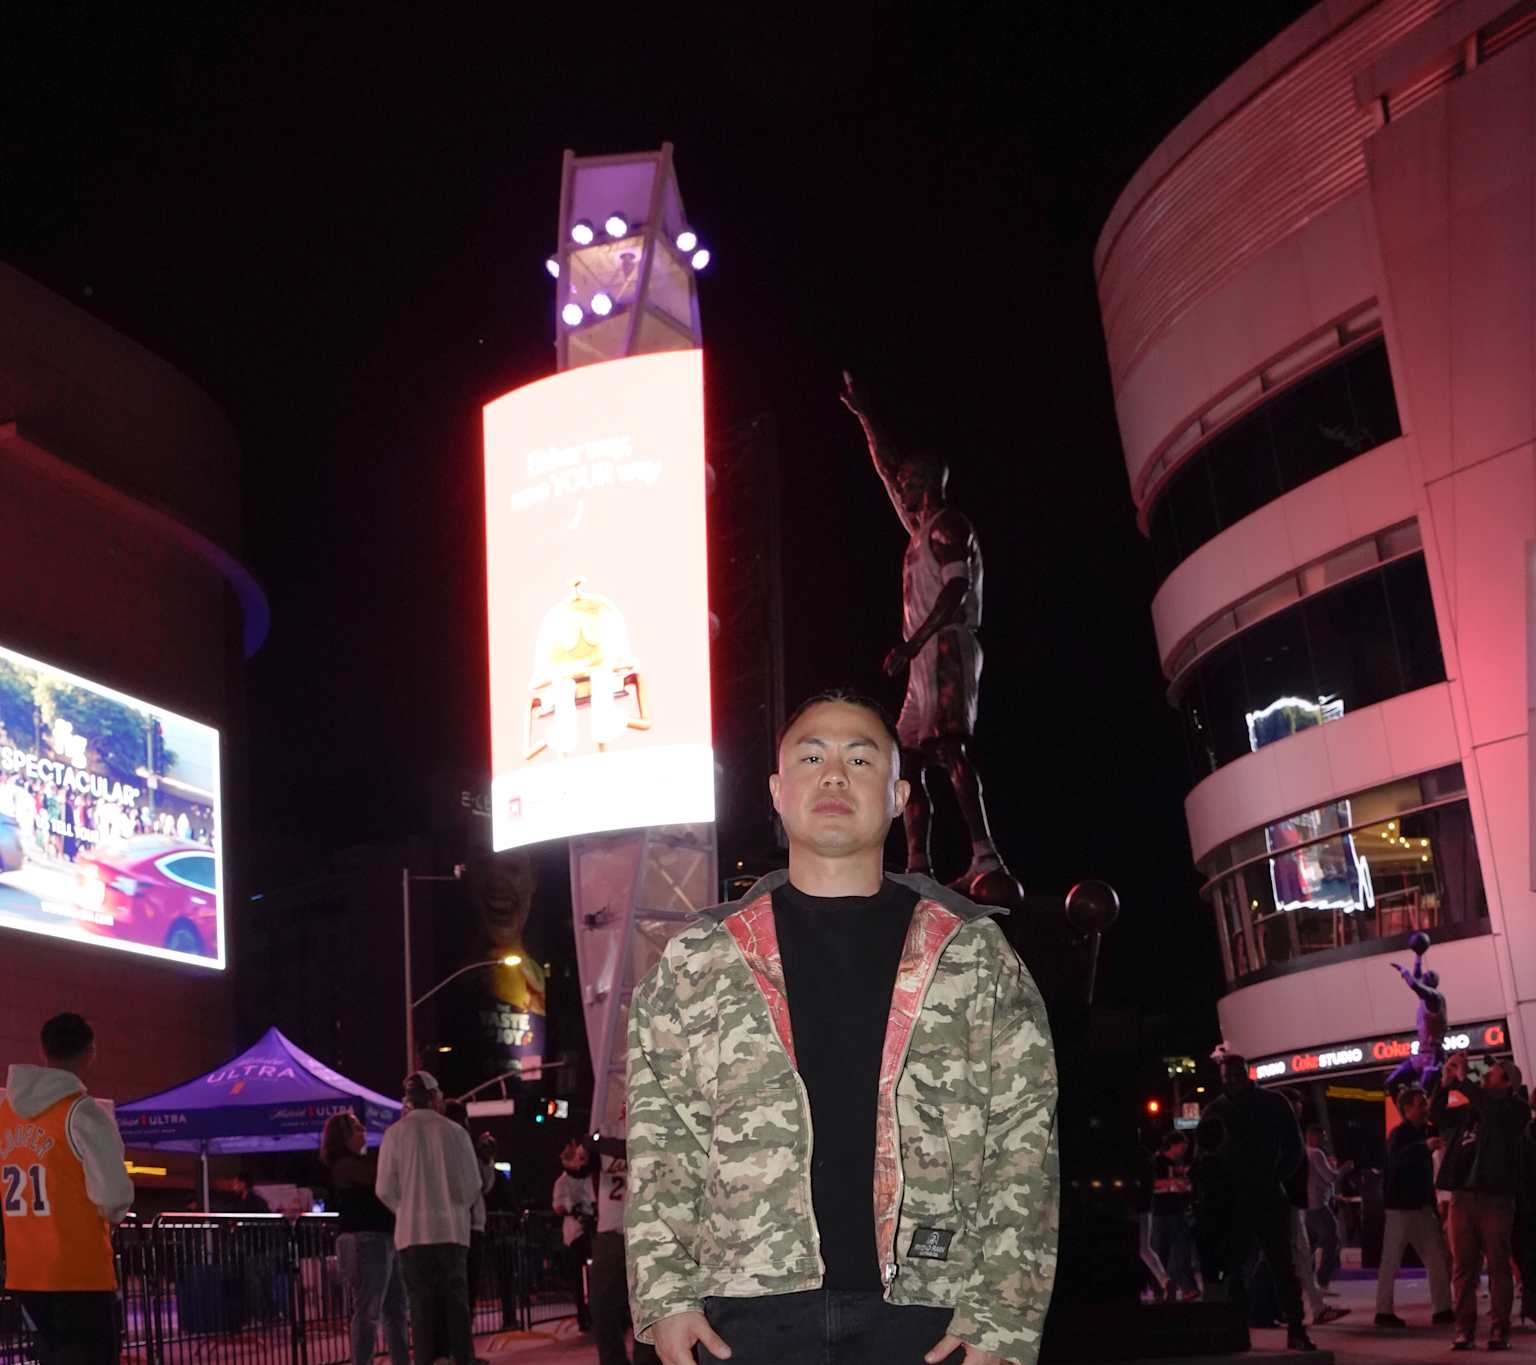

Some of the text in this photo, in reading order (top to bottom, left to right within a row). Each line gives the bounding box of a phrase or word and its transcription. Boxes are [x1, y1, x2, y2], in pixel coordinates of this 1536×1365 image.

[1318, 1048, 1363, 1067] STUDIO
[206, 1065, 296, 1084] ULTRA
[149, 1113, 187, 1126] ULTRA
[2, 1164, 52, 1216] 21
